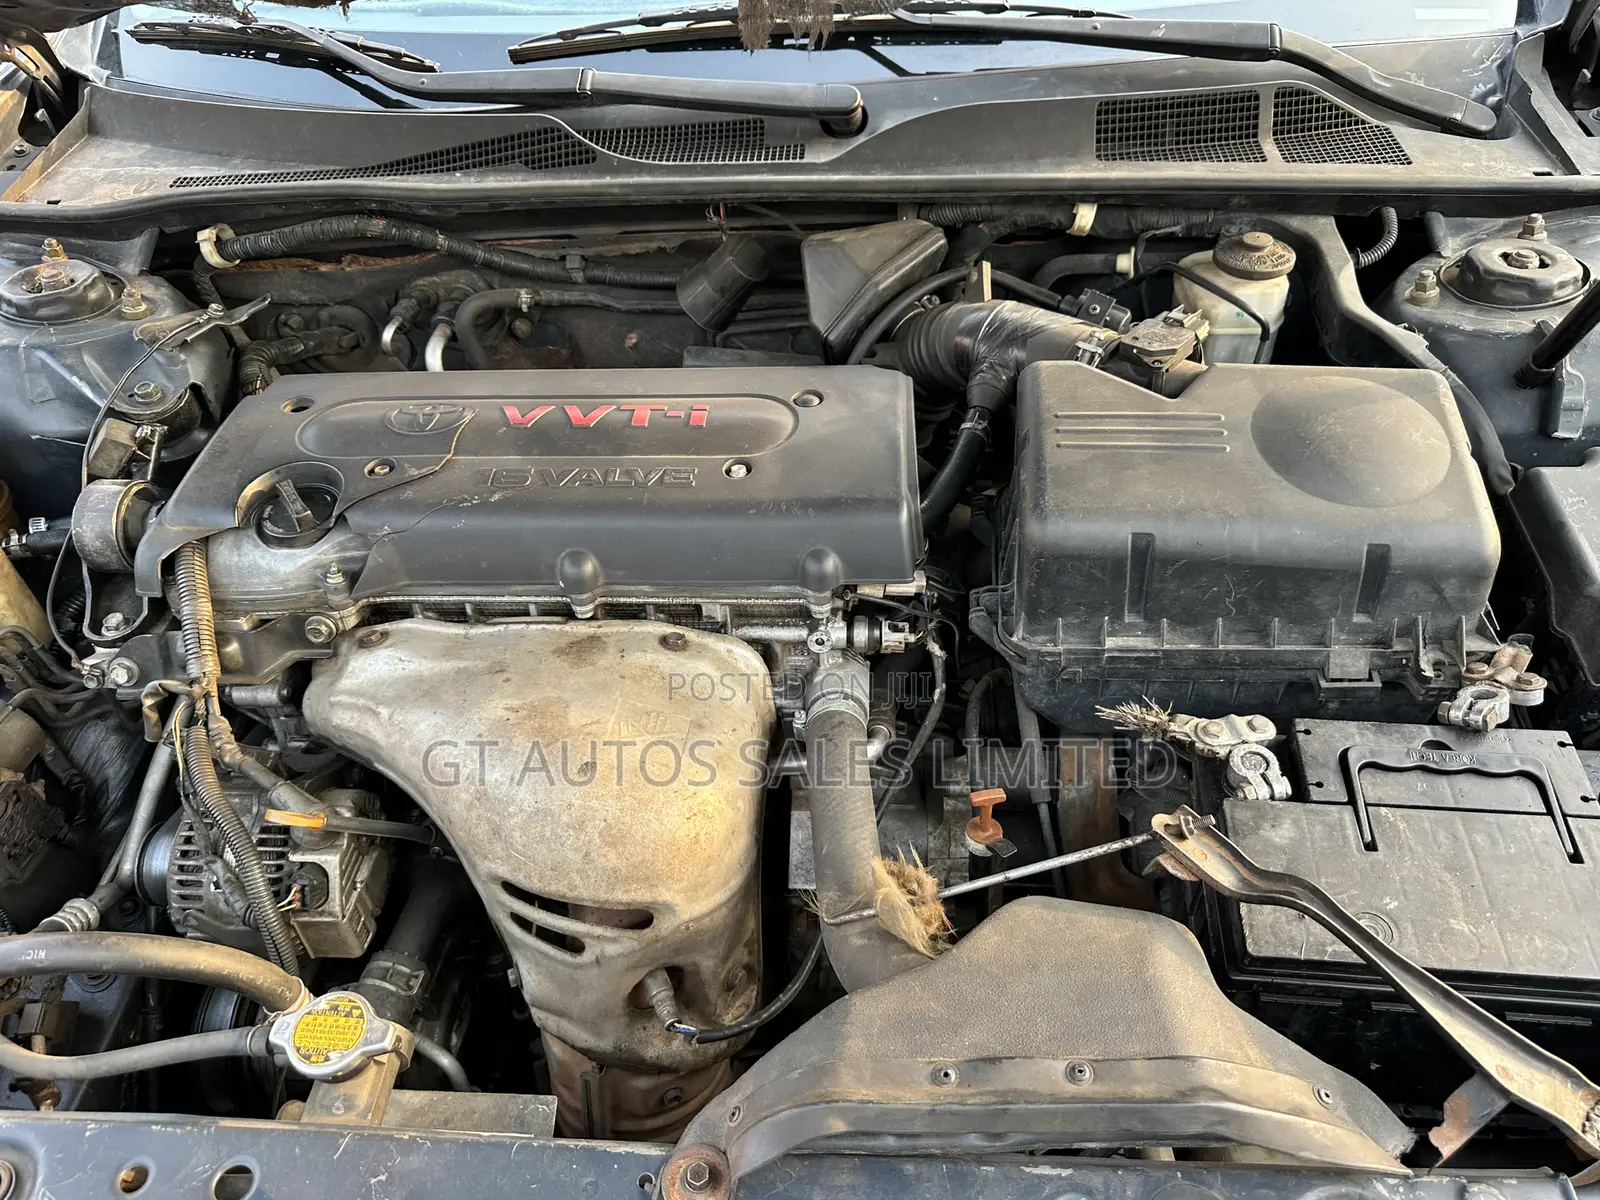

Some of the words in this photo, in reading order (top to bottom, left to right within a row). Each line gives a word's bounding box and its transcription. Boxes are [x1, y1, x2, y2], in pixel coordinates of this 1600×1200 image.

[501, 404, 709, 428] VVT-i
[1439, 753, 1478, 765] KOREA
[299, 1046, 332, 1057] AUTION
